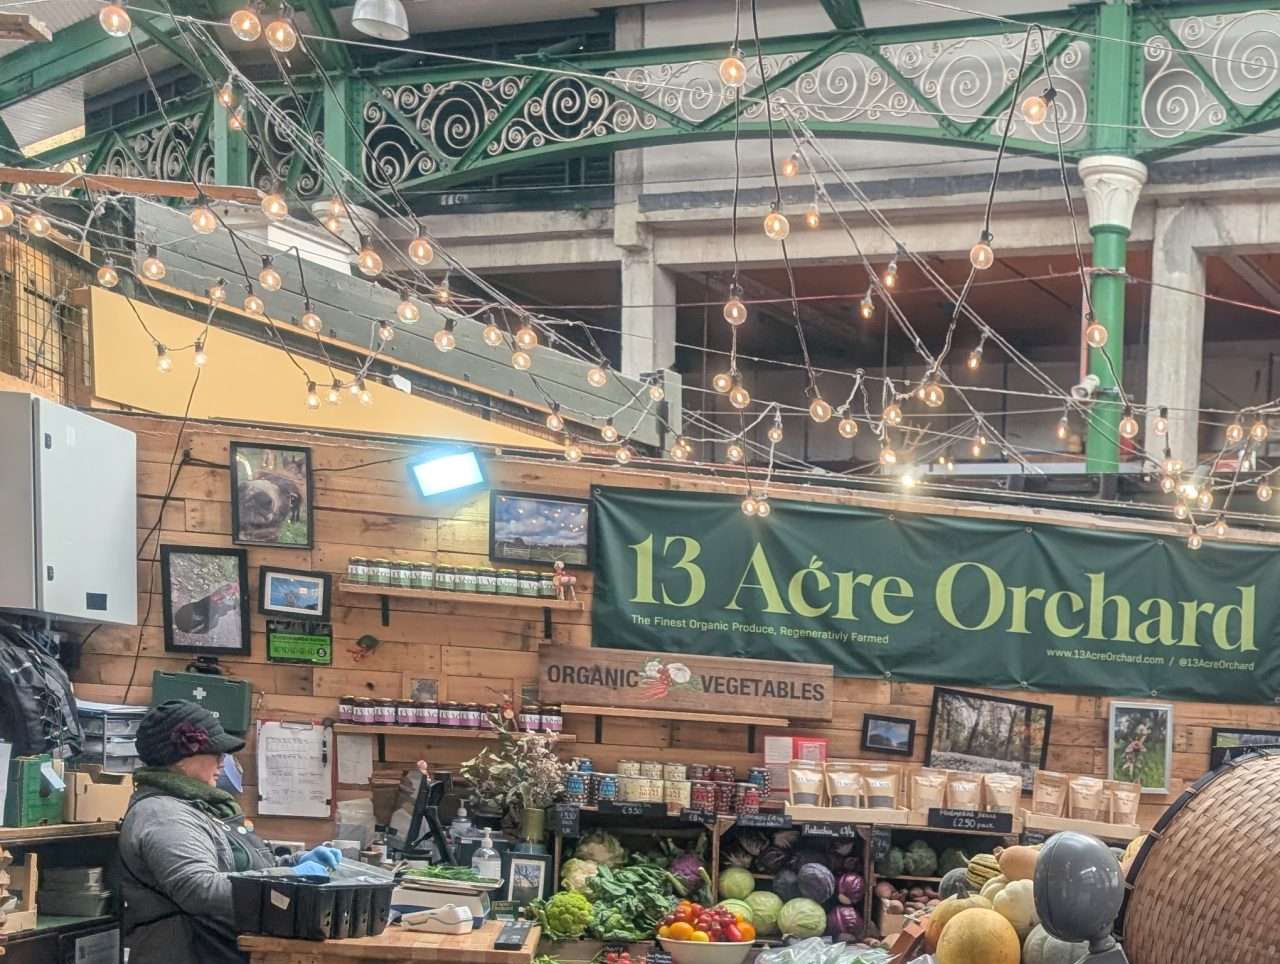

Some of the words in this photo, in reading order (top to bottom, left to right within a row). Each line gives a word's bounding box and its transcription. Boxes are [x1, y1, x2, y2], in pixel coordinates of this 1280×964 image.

[628, 534, 707, 608] 13
[935, 561, 1258, 653] Orchard
[631, 614, 650, 625] The
[654, 616, 686, 628] Finest
[689, 620, 729, 633] Organic
[732, 622, 777, 635] Produce,
[851, 631, 889, 644] Farmed
[1047, 648, 1164, 665] www.13AcreOrchard.com
[1179, 657, 1254, 671] @13AcreOrchard
[547, 664, 640, 689] ORGANIC
[700, 674, 825, 701] VEGETABLES
